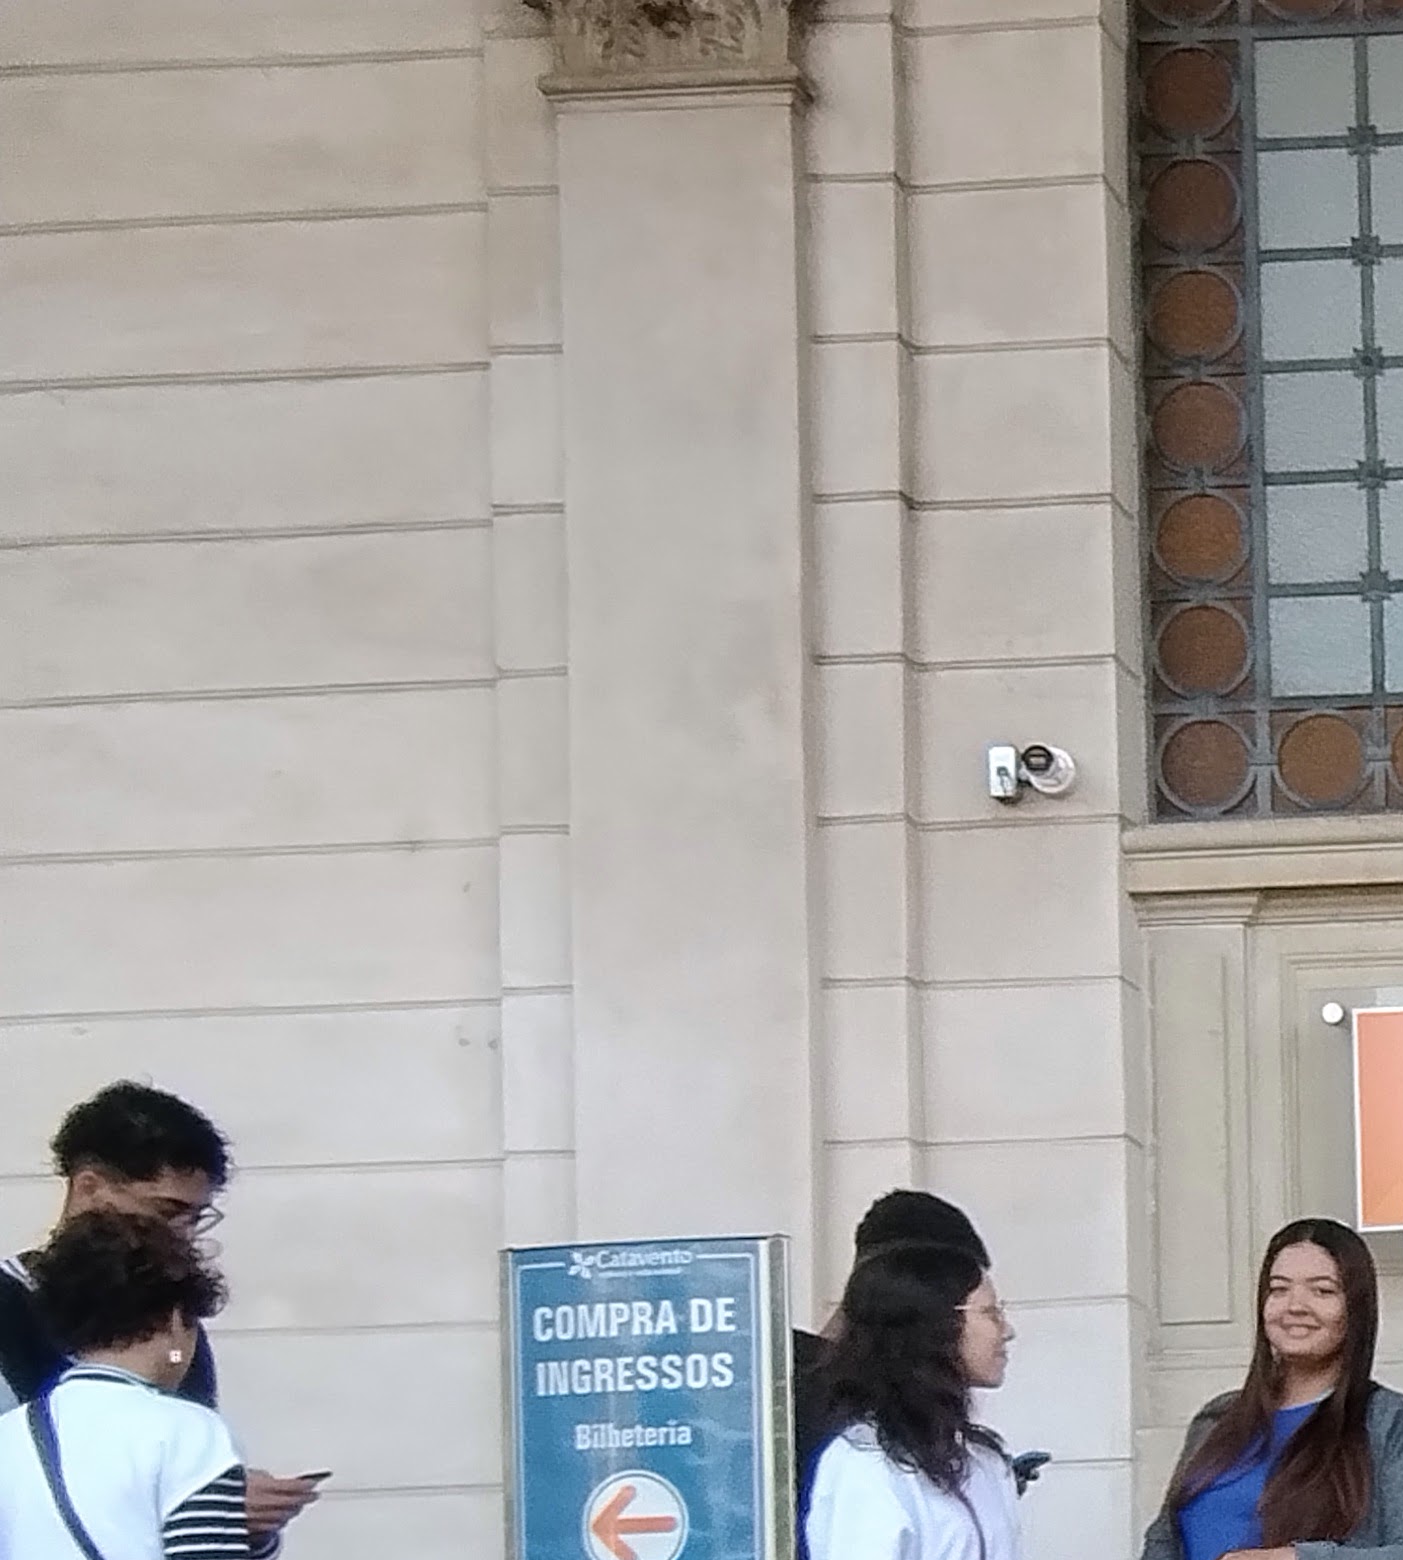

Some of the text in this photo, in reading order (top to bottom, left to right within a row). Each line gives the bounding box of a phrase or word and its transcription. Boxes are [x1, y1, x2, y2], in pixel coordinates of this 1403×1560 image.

[595, 1249, 693, 1269] Catavento
[533, 1297, 737, 1342] COMPRA DE
[536, 1352, 735, 1397] INGRESSOS
[575, 1420, 693, 1450] Bilheteria
